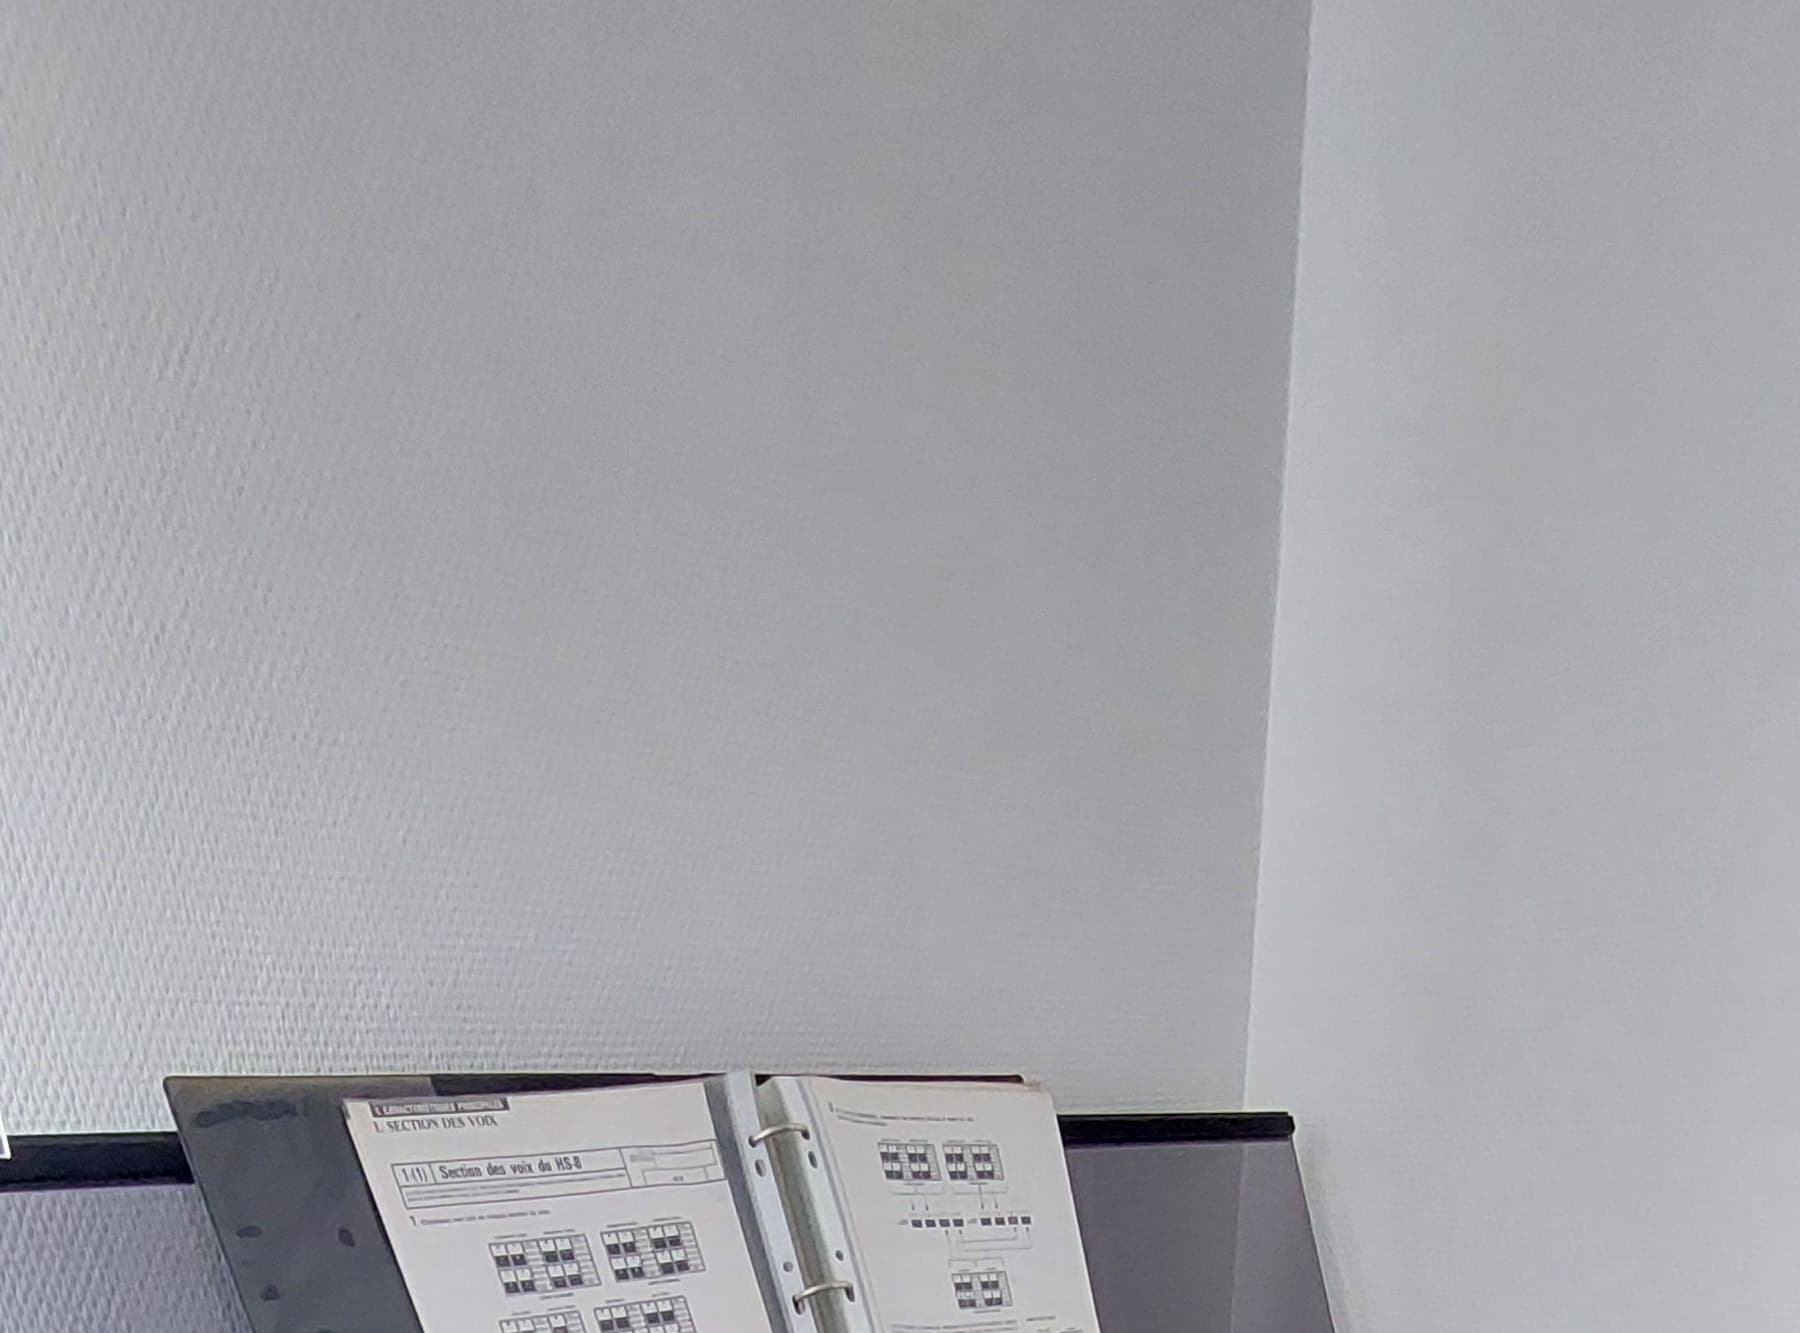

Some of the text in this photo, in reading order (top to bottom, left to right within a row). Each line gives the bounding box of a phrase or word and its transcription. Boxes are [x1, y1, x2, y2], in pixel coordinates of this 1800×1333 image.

[386, 1118, 440, 1132] SECTION
[441, 1116, 466, 1129] DES
[467, 1114, 499, 1128] VOIX
[439, 1164, 482, 1180] Section
[486, 1161, 507, 1176] des
[510, 1160, 535, 1174] voix
[537, 1158, 552, 1172] du
